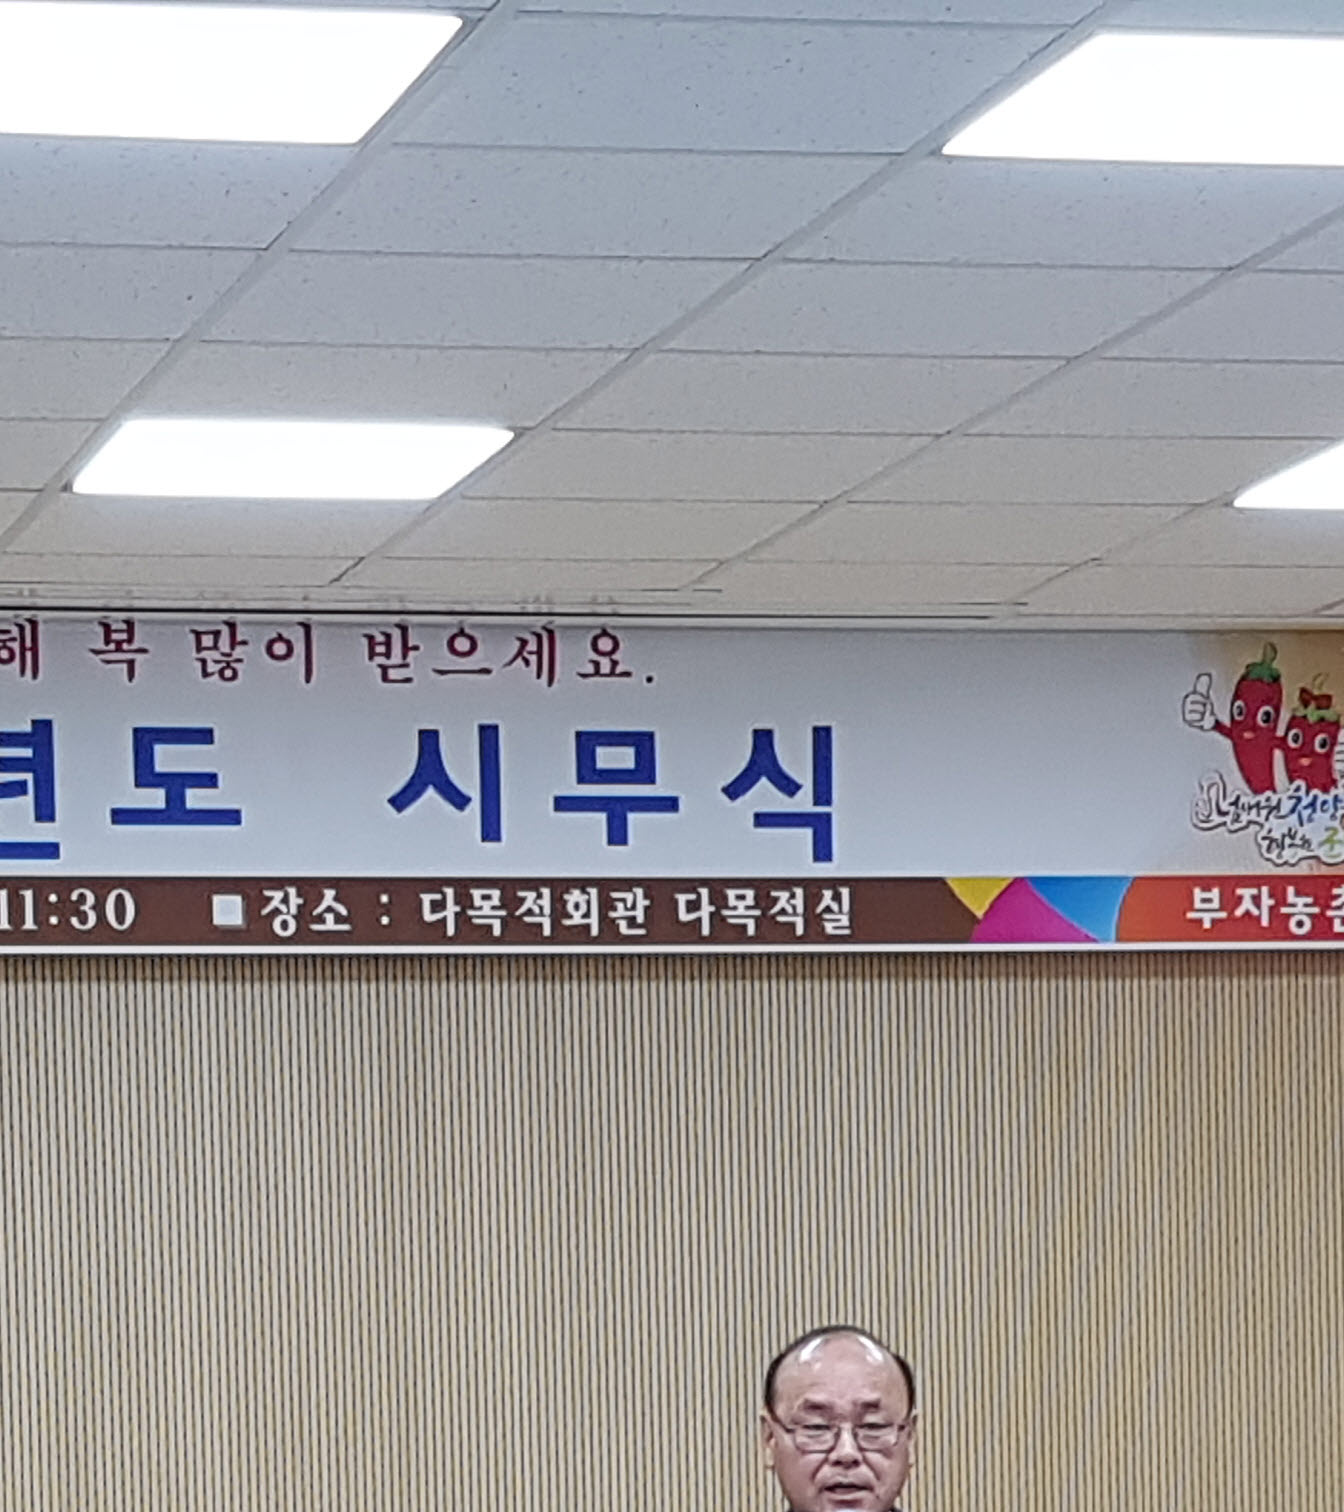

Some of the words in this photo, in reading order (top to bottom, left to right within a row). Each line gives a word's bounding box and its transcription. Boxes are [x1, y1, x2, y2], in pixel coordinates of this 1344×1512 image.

[88, 618, 149, 683] 복
[190, 619, 315, 685] 많이
[362, 623, 656, 688] 받으세요.
[386, 723, 834, 864] 시무식
[260, 887, 353, 936] 장소
[420, 886, 651, 938] 다목적회관
[674, 886, 854, 938] 다목적실
